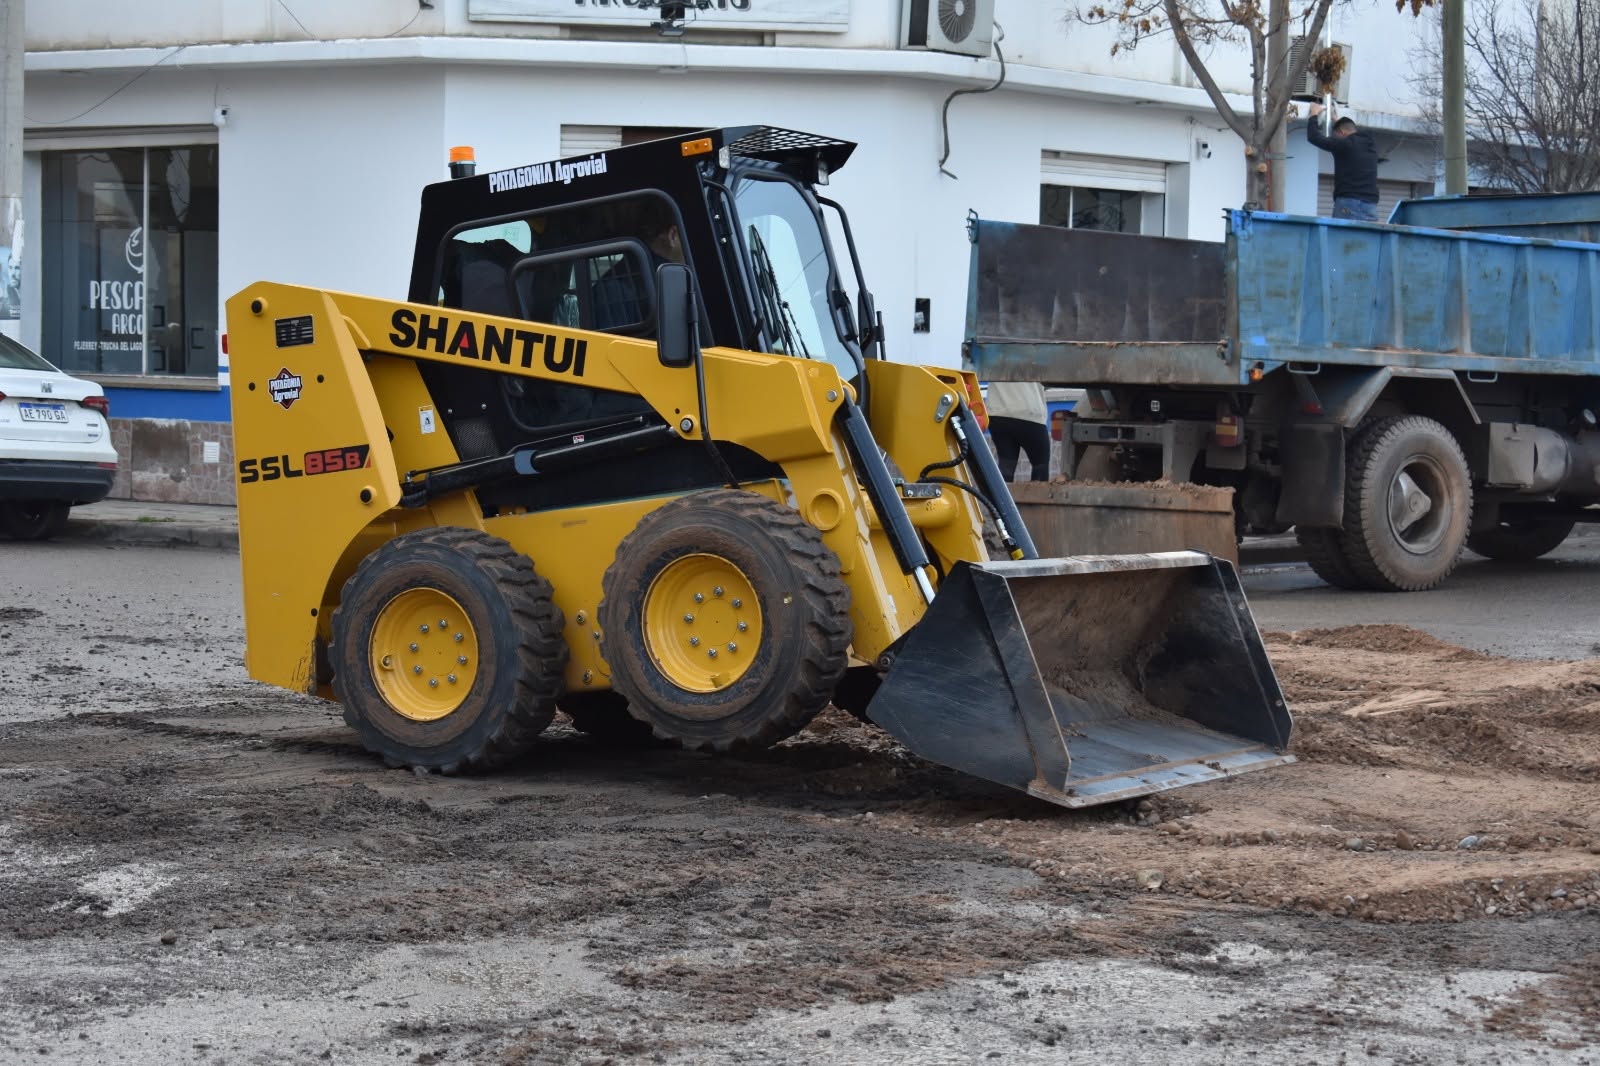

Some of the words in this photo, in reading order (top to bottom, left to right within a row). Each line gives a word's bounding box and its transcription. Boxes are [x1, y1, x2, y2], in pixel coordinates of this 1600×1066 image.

[489, 162, 553, 193] PATAGONIA
[555, 153, 607, 184] Agrovial
[389, 309, 588, 377] SHANTUI
[270, 376, 301, 391] PATAGONIA
[274, 388, 299, 402] Agrovial
[24, 409, 35, 419] AE
[36, 409, 53, 420] 790
[54, 410, 66, 421] GA
